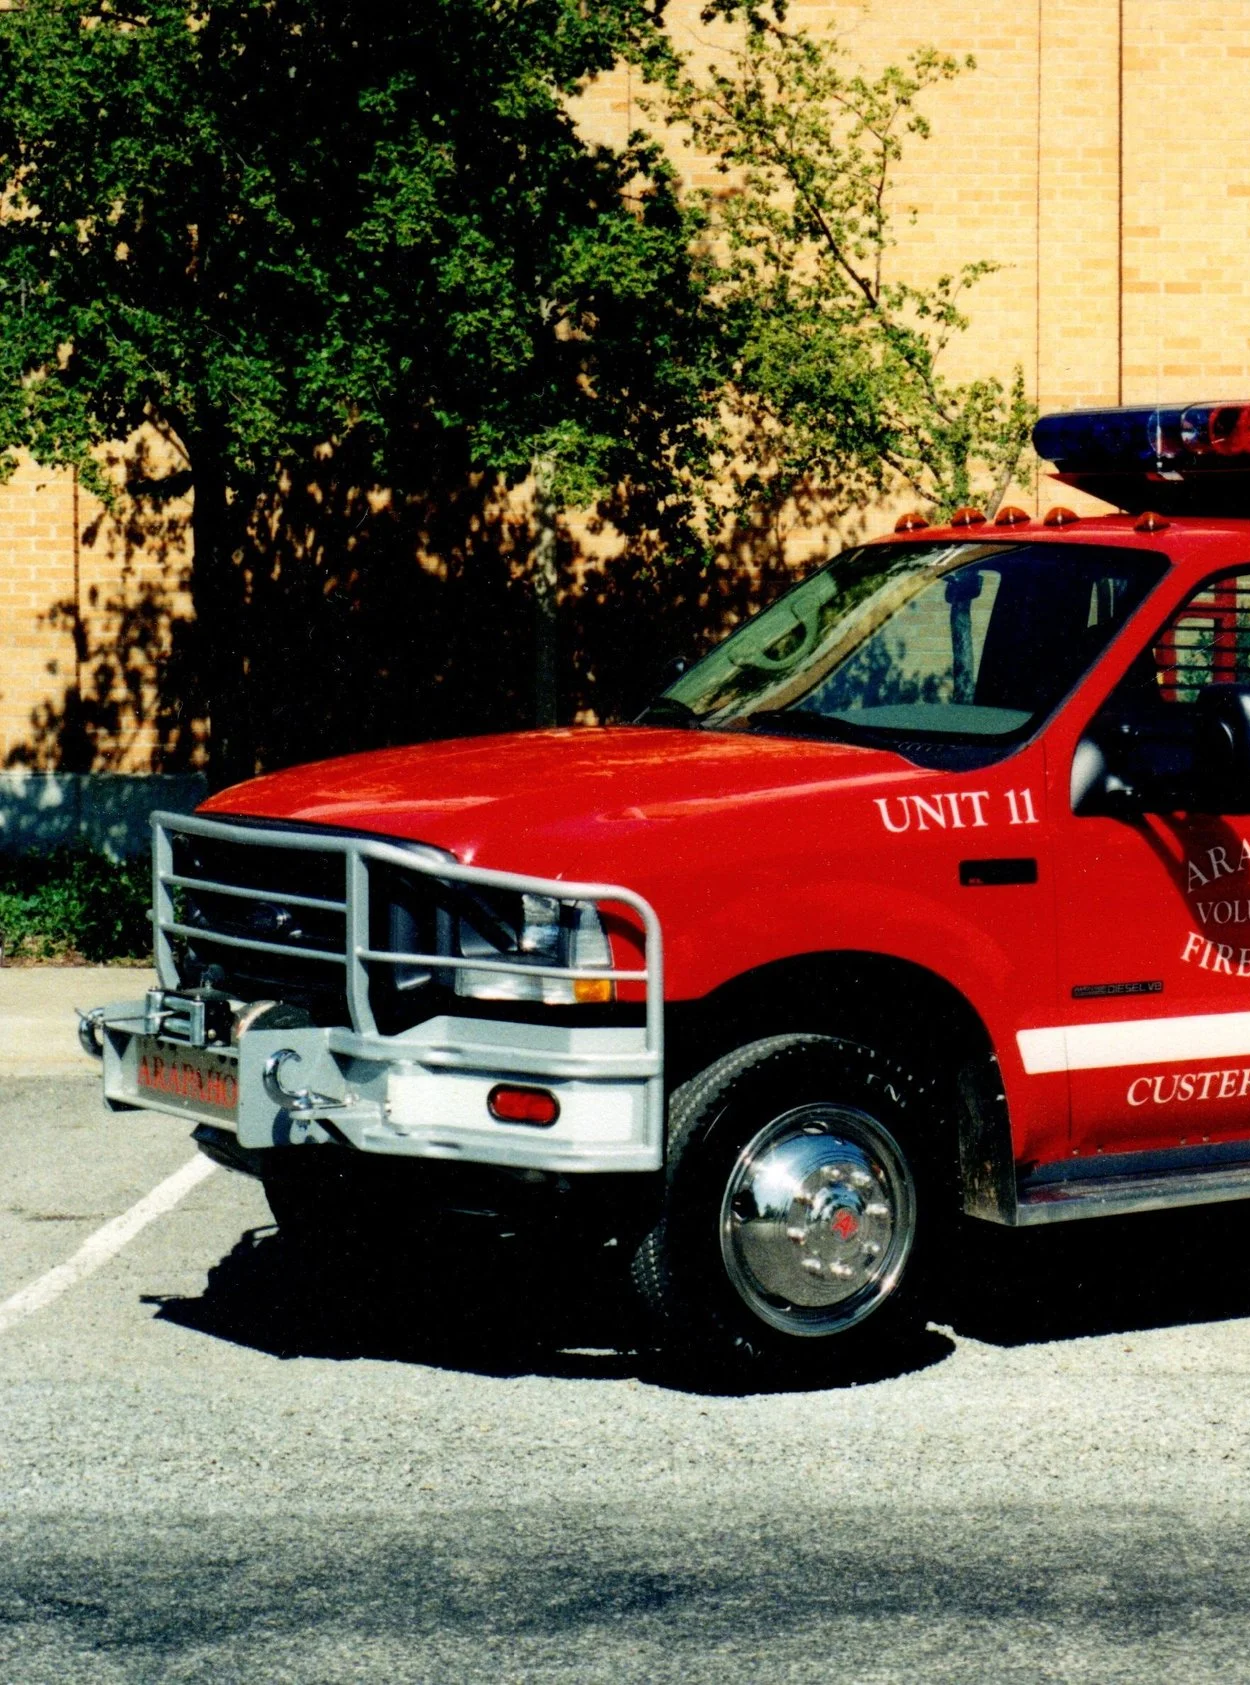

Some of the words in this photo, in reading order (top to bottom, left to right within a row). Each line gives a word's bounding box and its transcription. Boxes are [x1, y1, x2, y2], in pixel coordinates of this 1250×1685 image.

[873, 790, 990, 833] UNIT
[1004, 788, 1040, 825] 11
[1107, 983, 1146, 994] DIESEL
[137, 1055, 238, 1110] ARAPAHO
